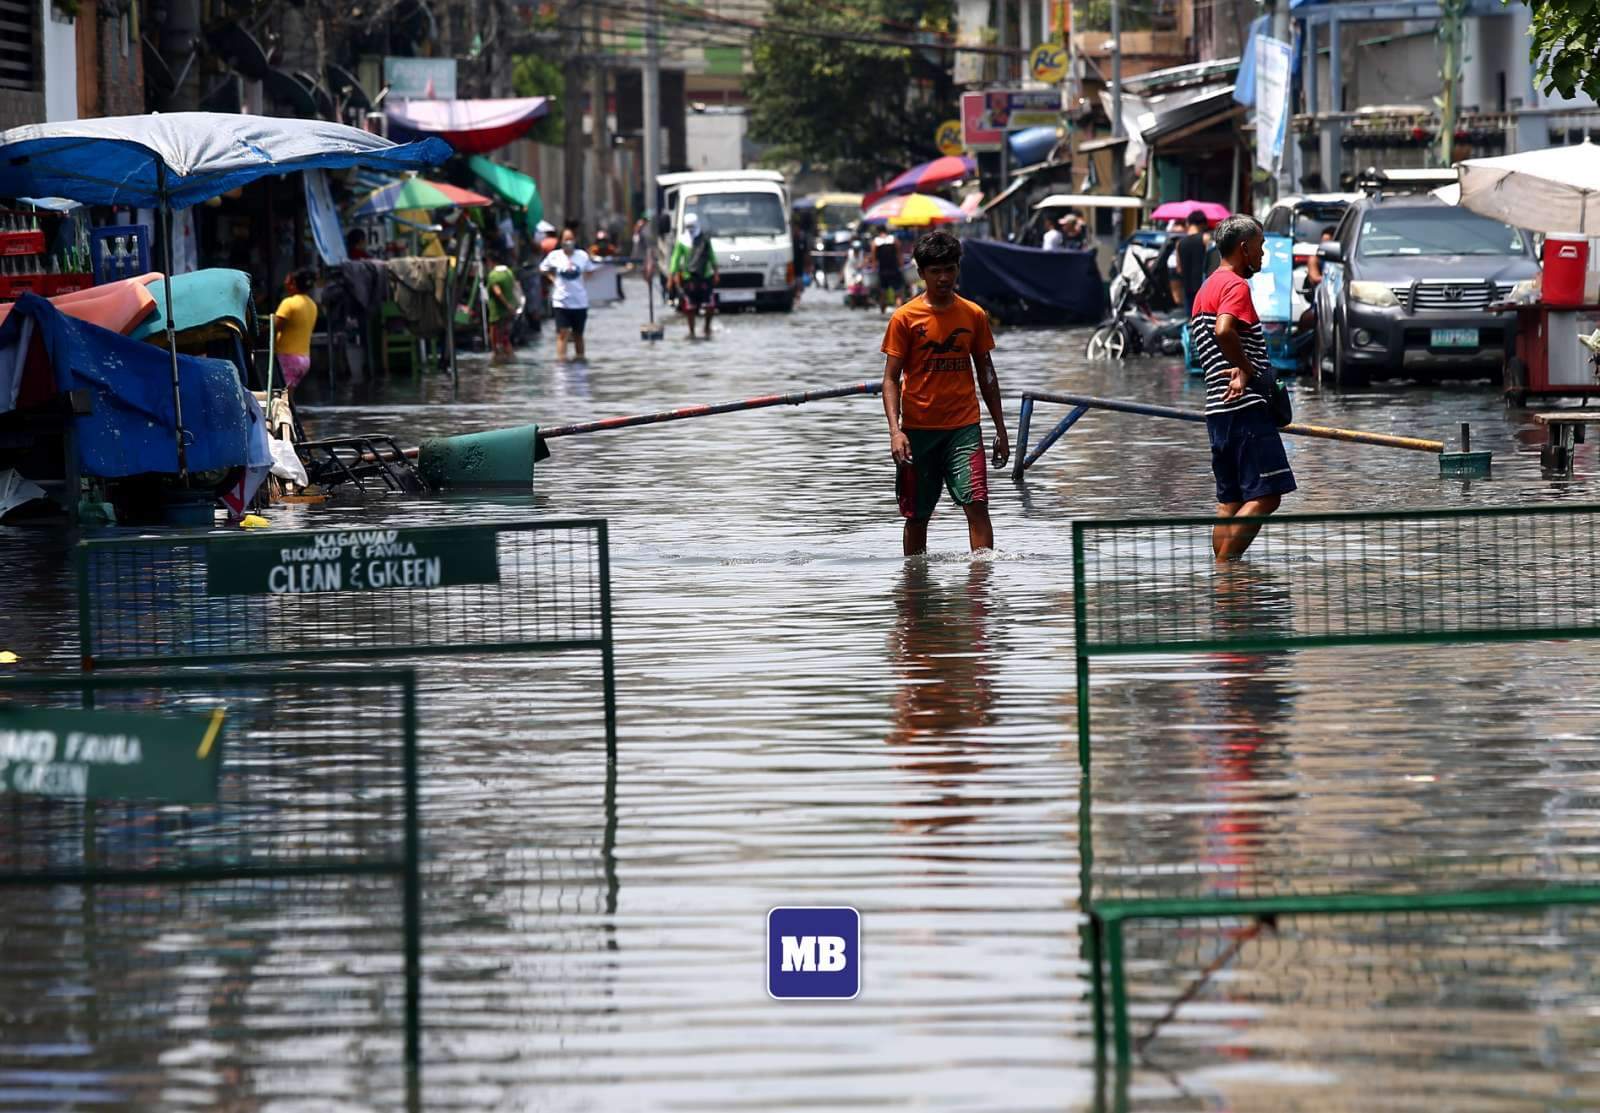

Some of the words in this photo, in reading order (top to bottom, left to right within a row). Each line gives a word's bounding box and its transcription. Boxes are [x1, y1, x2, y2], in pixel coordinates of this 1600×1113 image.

[1033, 49, 1066, 70] RC
[281, 547, 342, 562] RICHARD
[366, 543, 417, 557] FAVILA
[268, 562, 342, 593] CLEAN
[368, 556, 441, 588] GREEN
